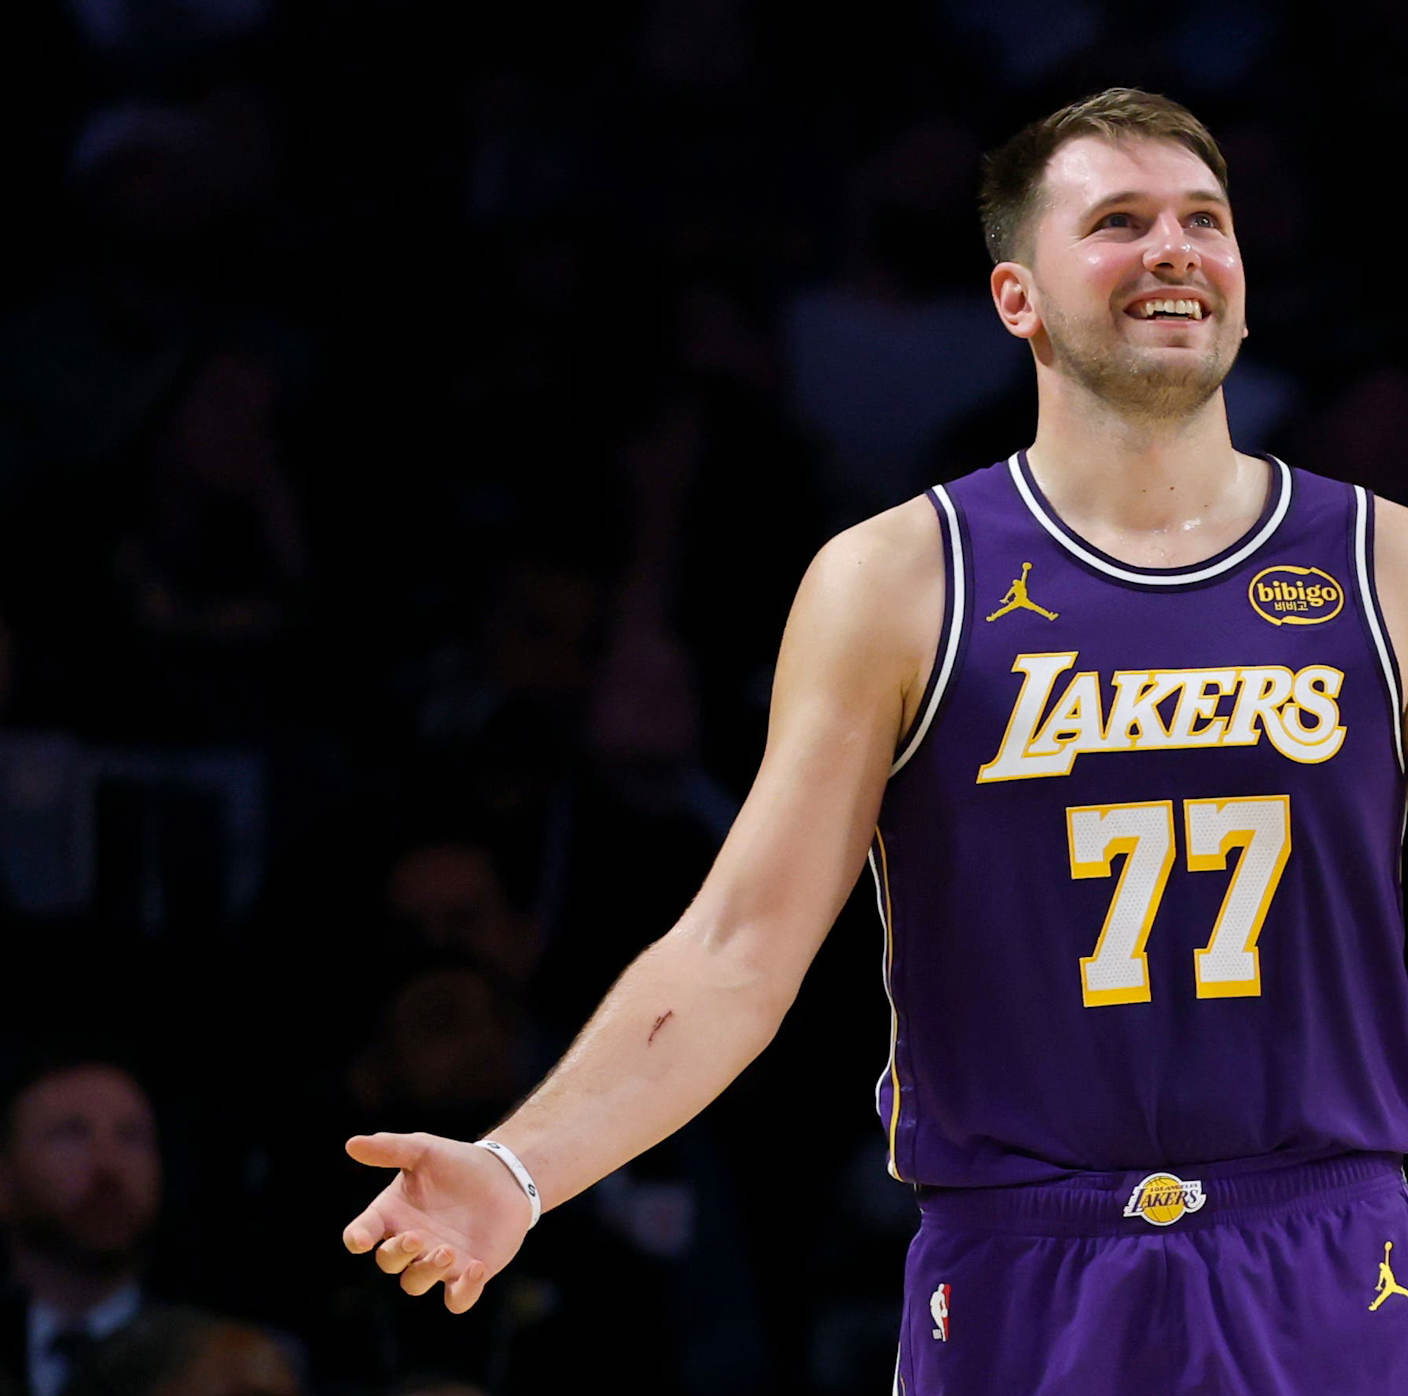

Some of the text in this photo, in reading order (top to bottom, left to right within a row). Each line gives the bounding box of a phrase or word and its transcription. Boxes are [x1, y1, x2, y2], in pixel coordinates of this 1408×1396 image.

[1257, 581, 1338, 607] bibigo
[1274, 601, 1309, 612] 비비고
[976, 651, 1348, 784] LAKERS
[1065, 794, 1292, 1008] 77
[1126, 1188, 1201, 1214] LAKERS
